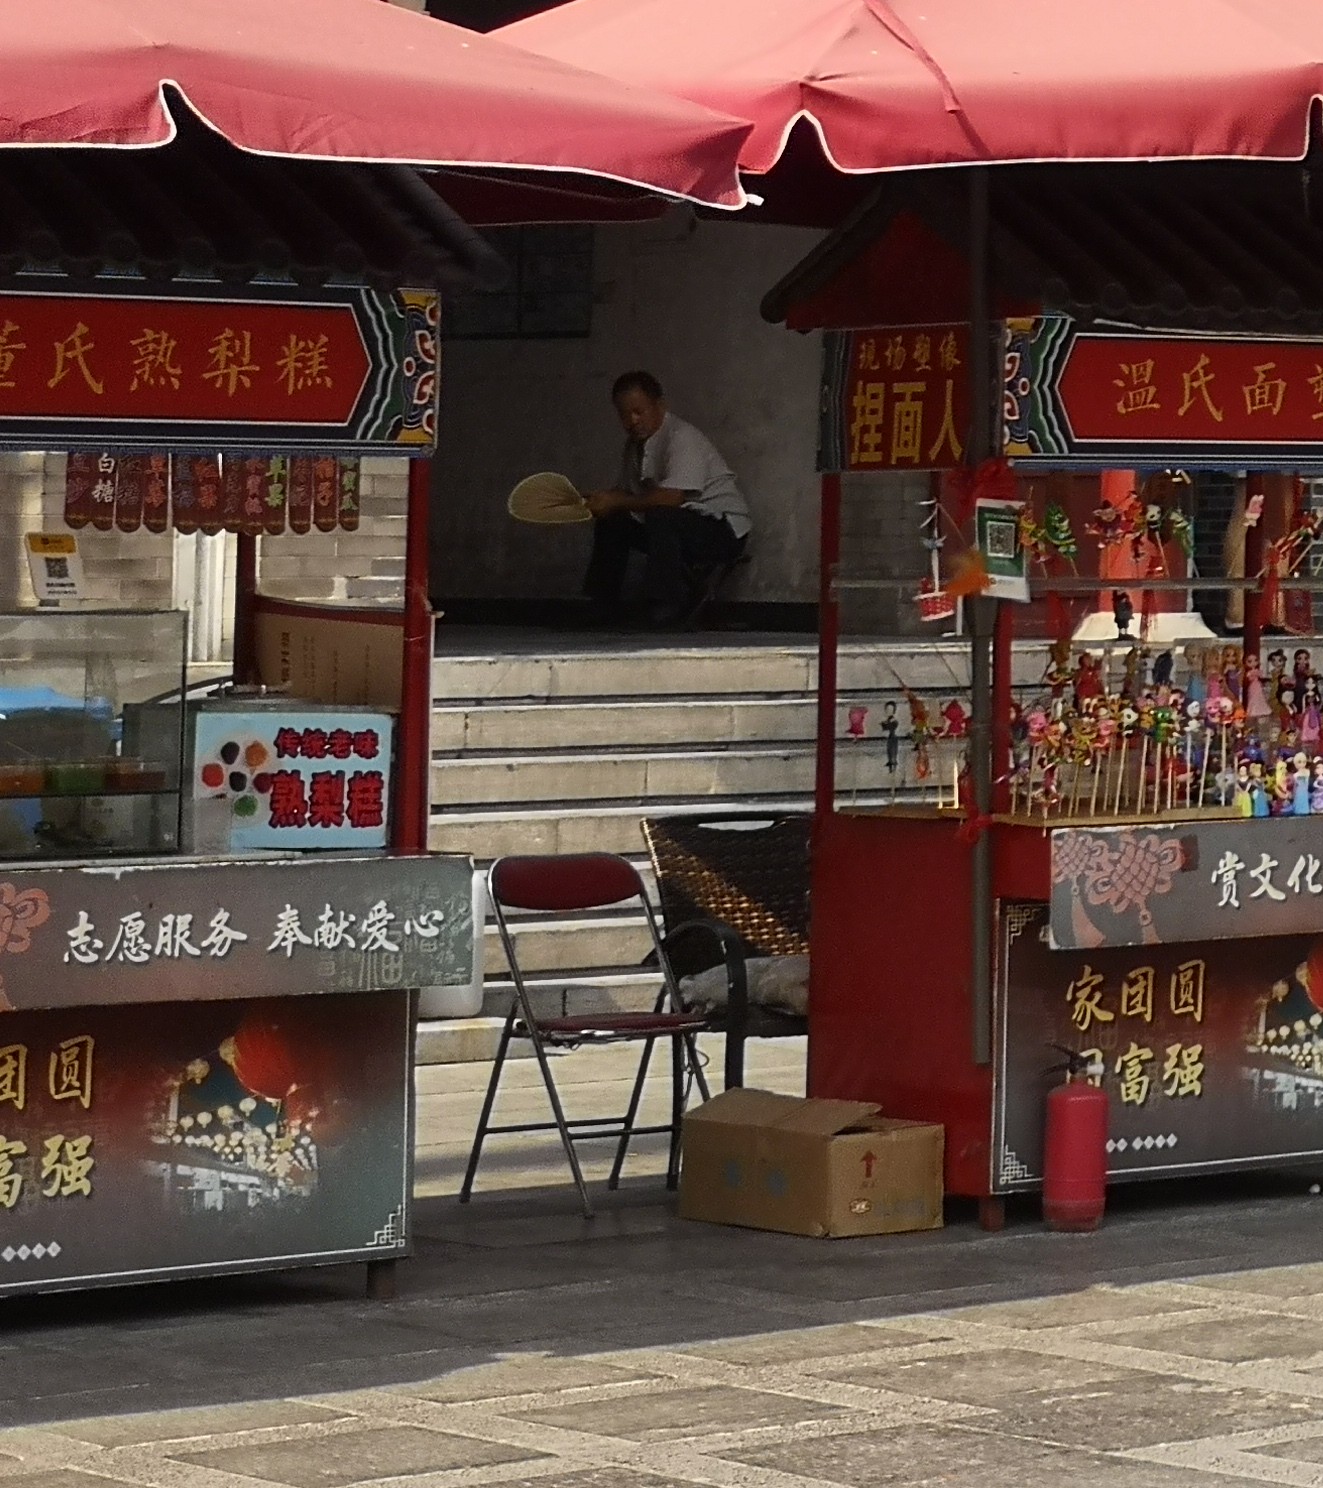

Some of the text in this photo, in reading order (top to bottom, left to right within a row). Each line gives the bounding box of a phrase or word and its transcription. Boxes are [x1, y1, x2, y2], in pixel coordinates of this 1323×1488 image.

[851, 380, 963, 465] 捏面人
[91, 452, 116, 504] 白糖
[273, 727, 380, 761] 传统老味
[268, 771, 386, 830] 熟梨糕
[1210, 850, 1323, 910] 赏文化
[62, 900, 445, 965] 志愿服务 奉献爱心
[1065, 958, 1207, 1032] 家团圆
